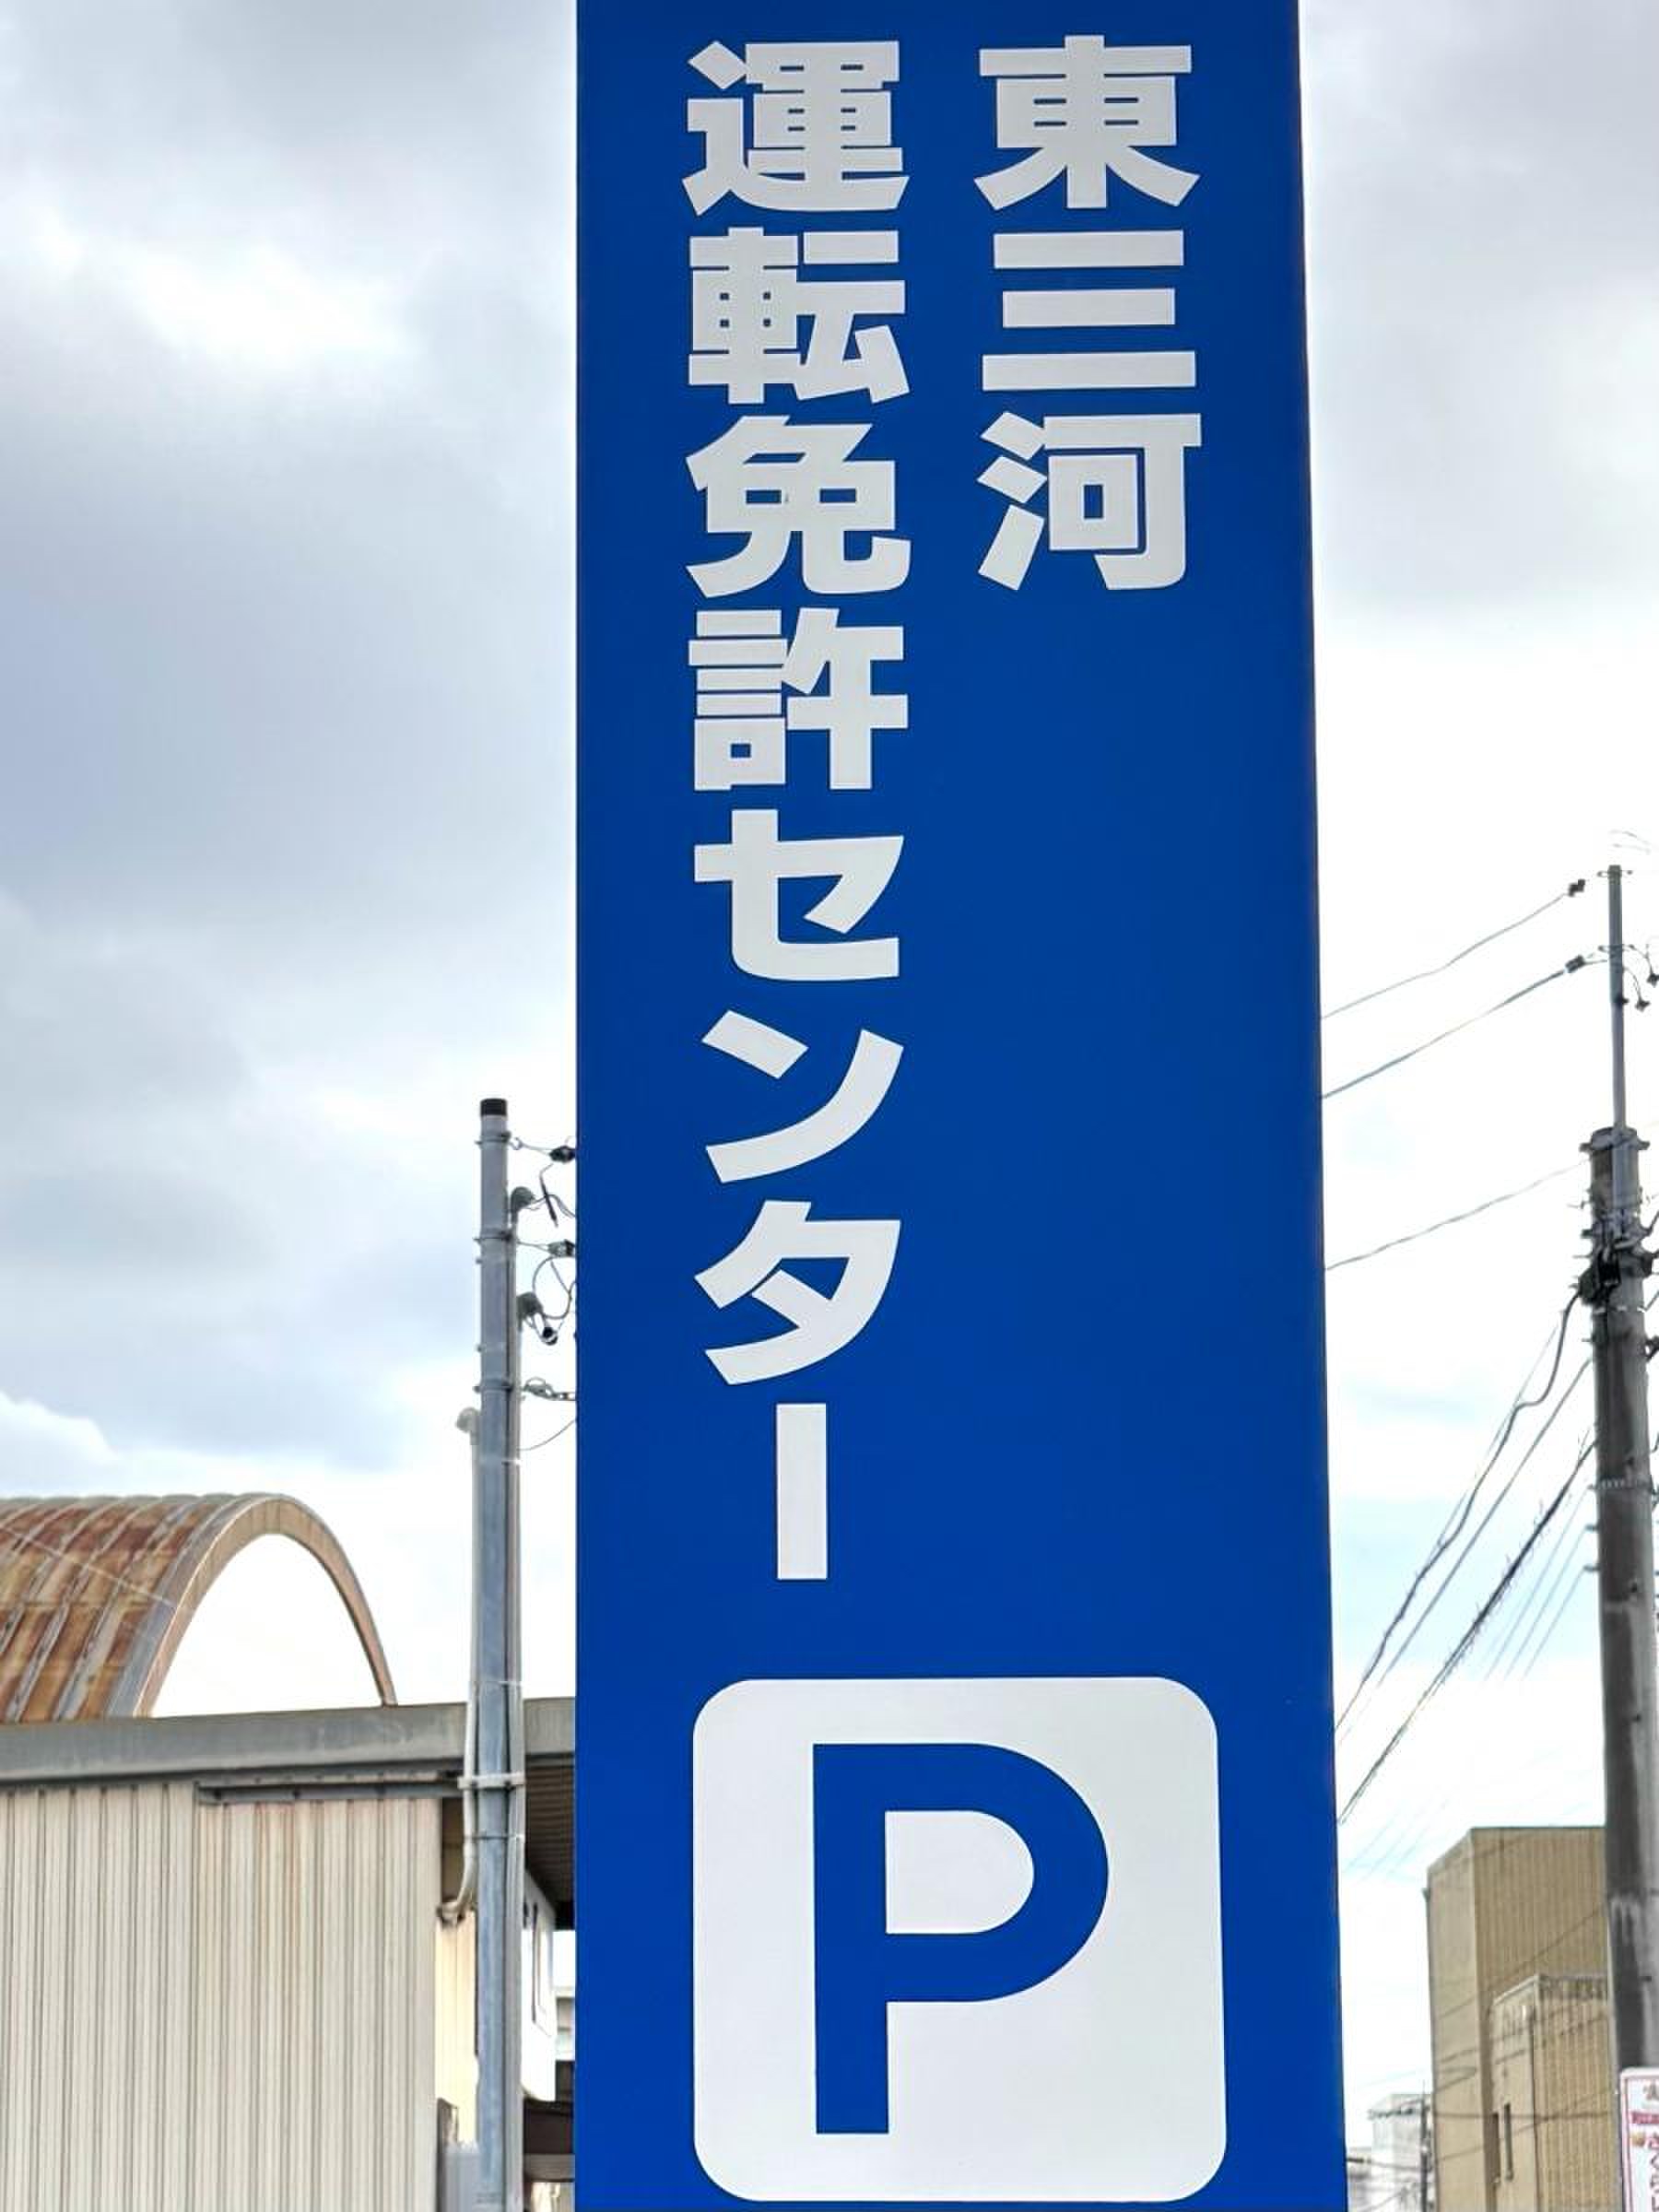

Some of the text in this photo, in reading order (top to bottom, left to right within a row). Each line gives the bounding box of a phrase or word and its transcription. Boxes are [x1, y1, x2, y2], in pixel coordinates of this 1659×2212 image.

[975, 36, 1201, 590] 東三河
[683, 41, 910, 1579] 運転免許センター
[813, 1743, 1109, 2134] P
